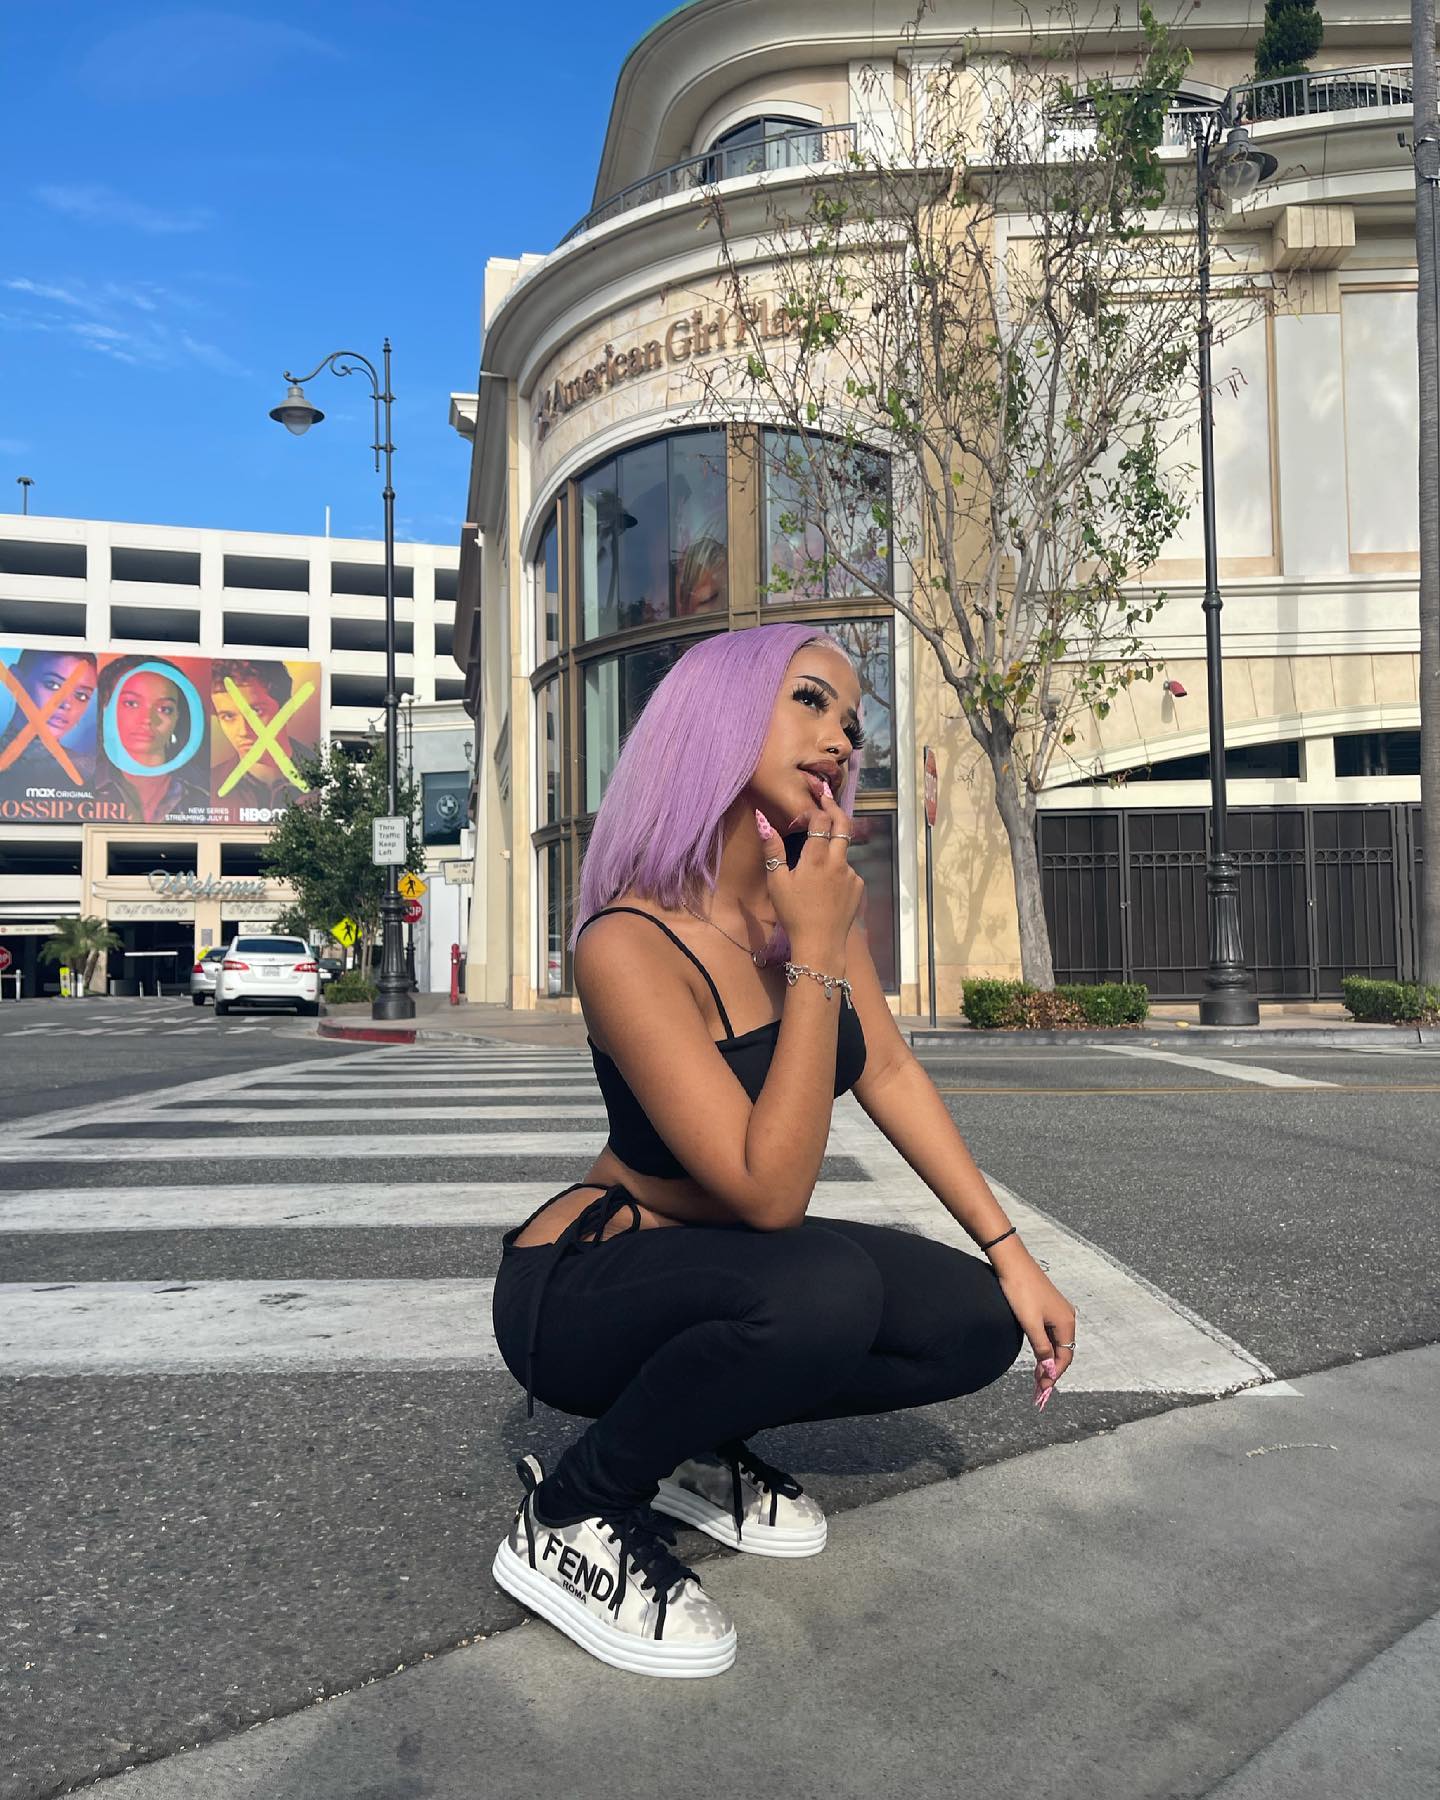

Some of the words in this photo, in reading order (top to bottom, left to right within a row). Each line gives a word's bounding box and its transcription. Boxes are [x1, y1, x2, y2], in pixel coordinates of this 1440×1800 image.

[547, 343, 662, 415] American
[666, 308, 727, 362] Girl
[26, 787, 56, 798] max
[56, 790, 94, 800] ORIGINAL
[0, 799, 74, 819] OSSIP
[76, 801, 132, 821] GIRL
[165, 814, 205, 822] STREAMING
[206, 814, 223, 822] JULY
[206, 807, 229, 815] SERIES
[148, 868, 267, 896] Welcome
[562, 1579, 588, 1605] ROMA
